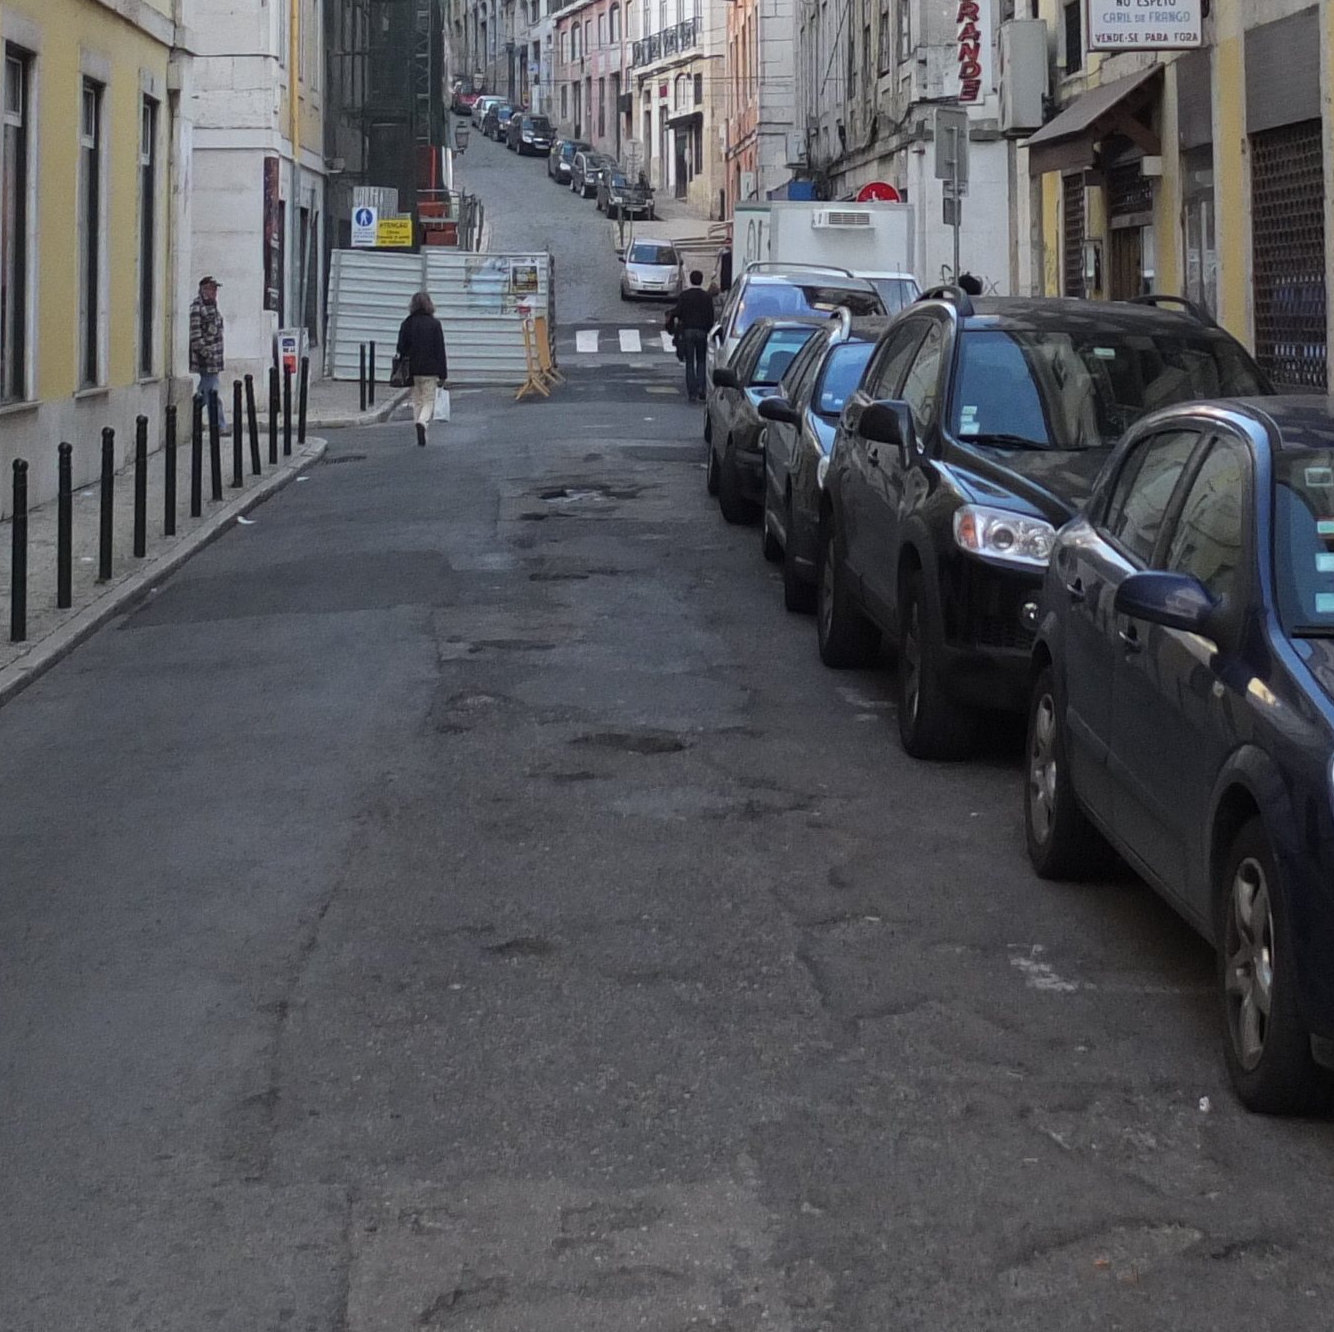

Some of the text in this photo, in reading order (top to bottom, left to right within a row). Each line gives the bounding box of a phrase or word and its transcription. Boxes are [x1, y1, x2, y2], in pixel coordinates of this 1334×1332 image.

[1149, 11, 1191, 23] FRANGO
[1095, 32, 1199, 43] VENDE-SE PARA FORA
